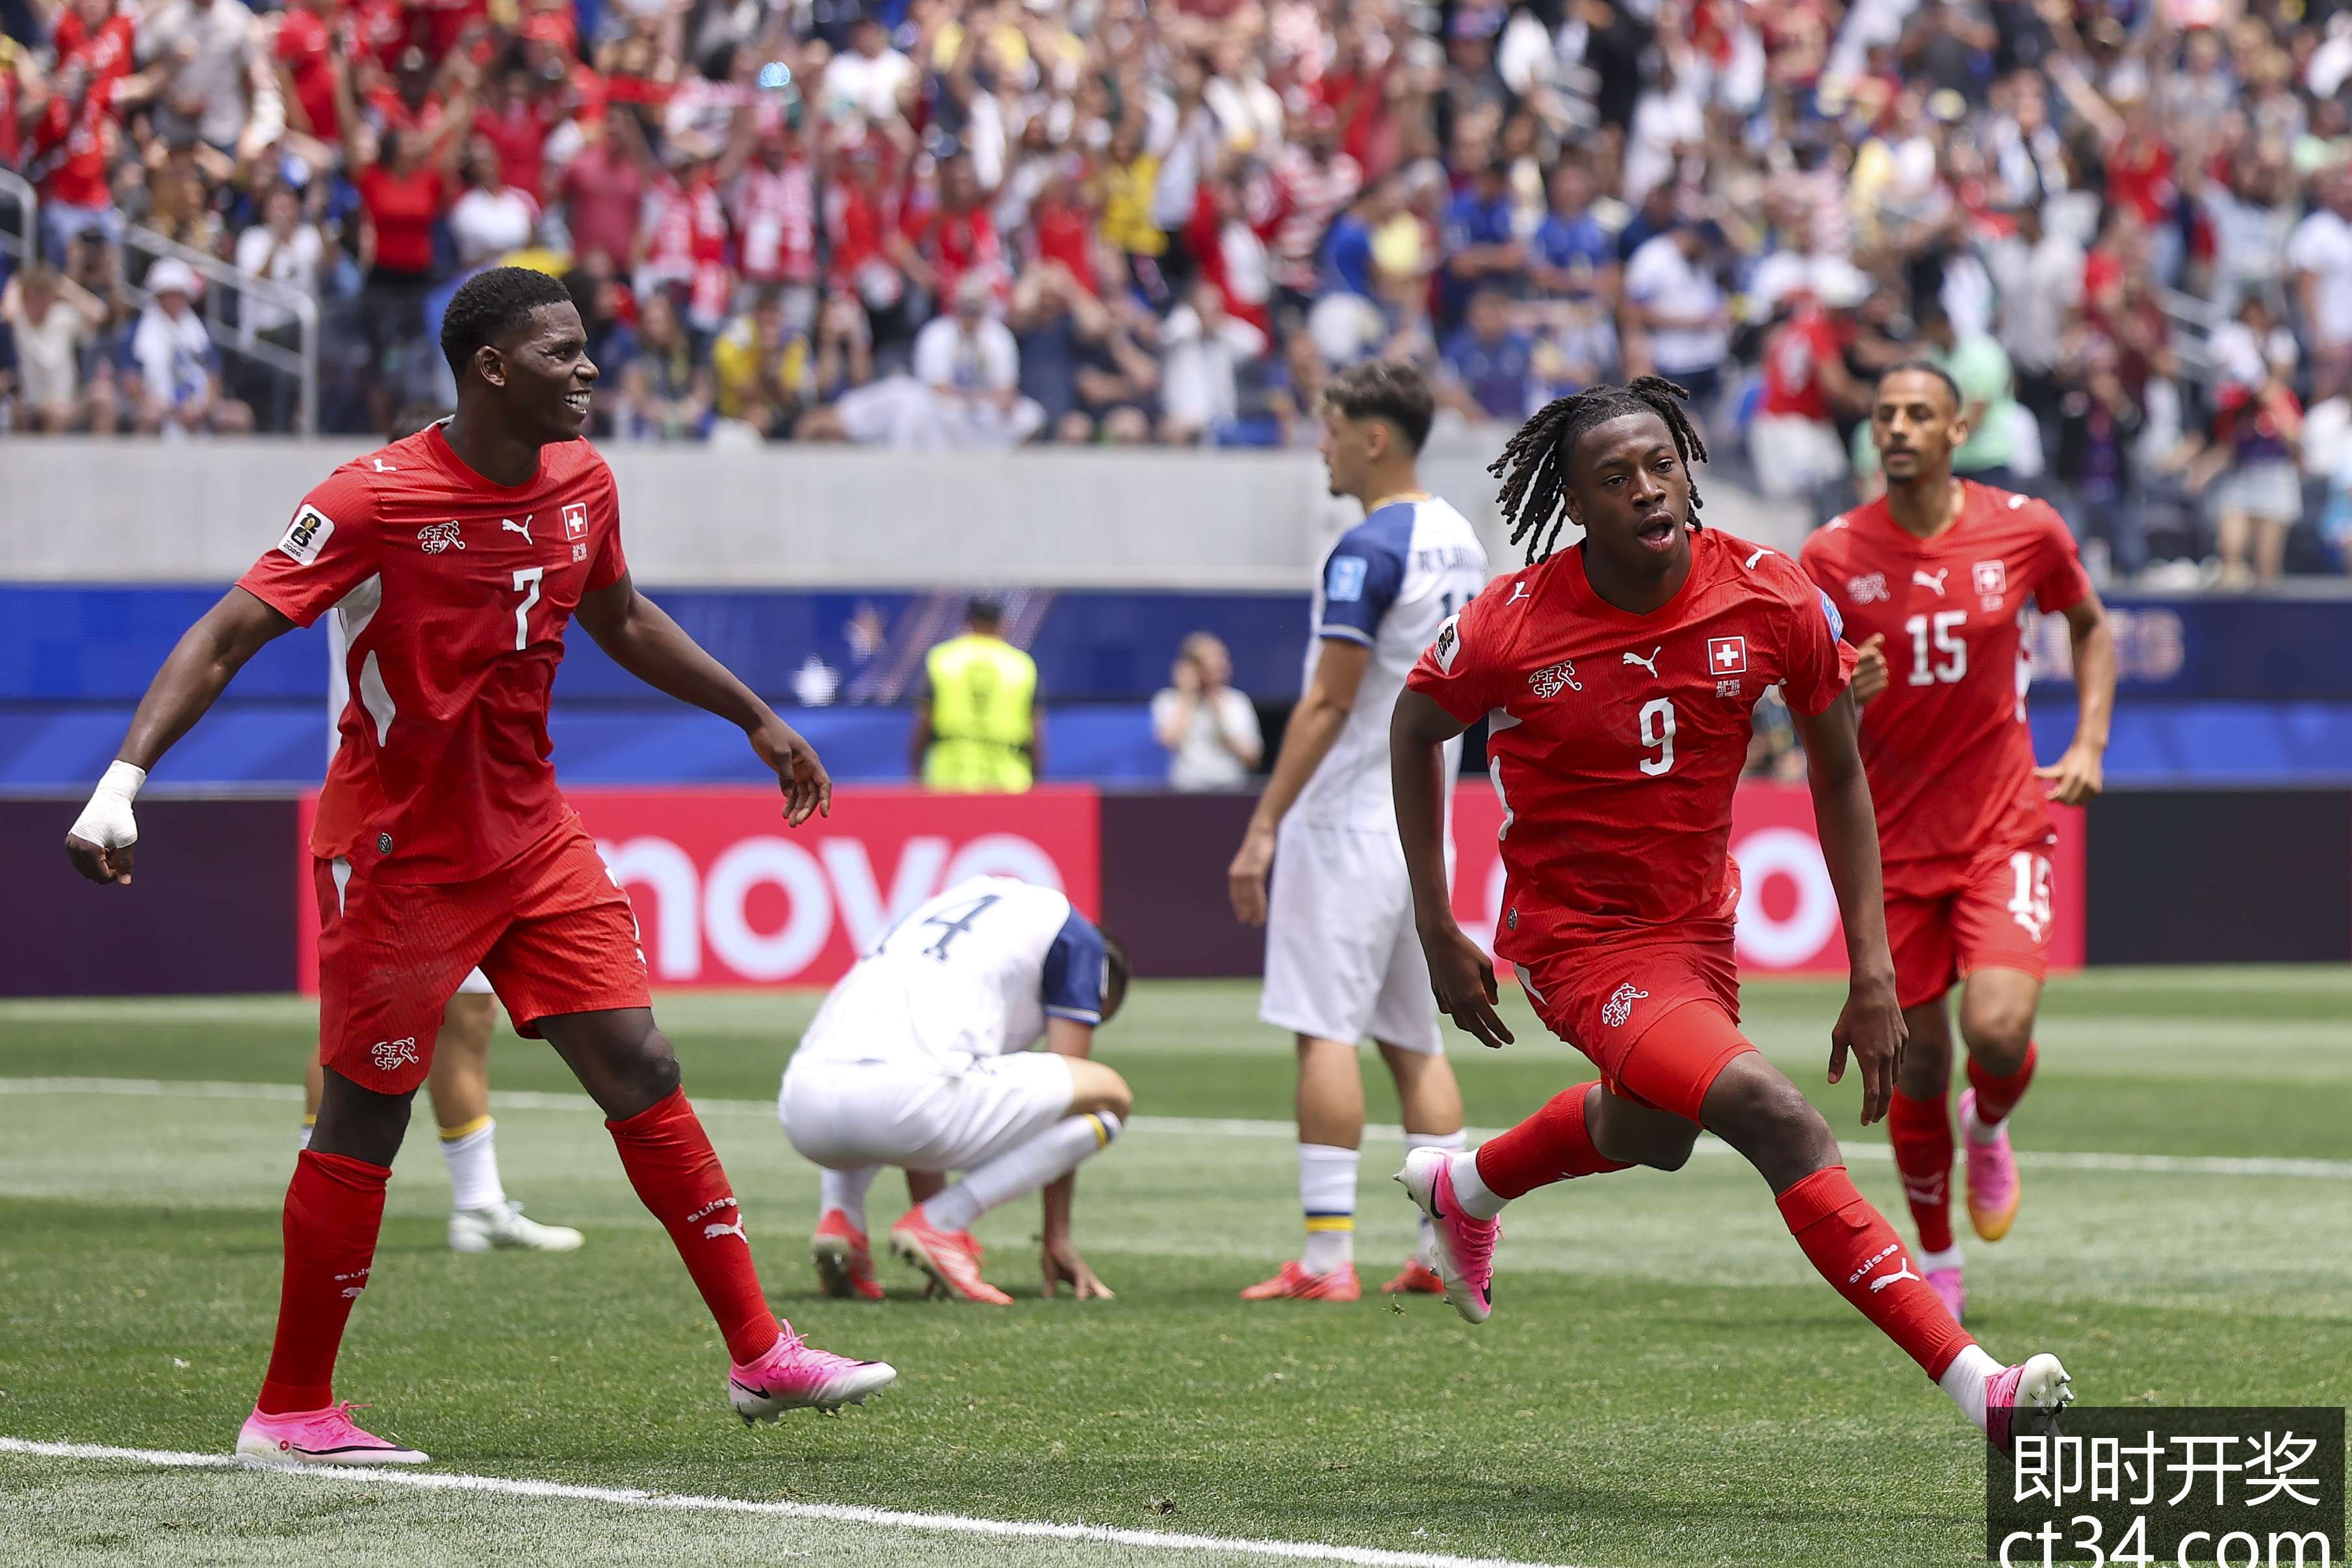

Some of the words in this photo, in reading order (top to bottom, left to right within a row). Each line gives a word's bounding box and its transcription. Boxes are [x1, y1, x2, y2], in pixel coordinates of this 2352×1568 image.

[511, 567, 544, 650] 7
[1904, 609, 1968, 686] 15
[1639, 697, 1675, 777] 9
[593, 833, 1064, 979] nov
[2008, 851, 2051, 923] 15
